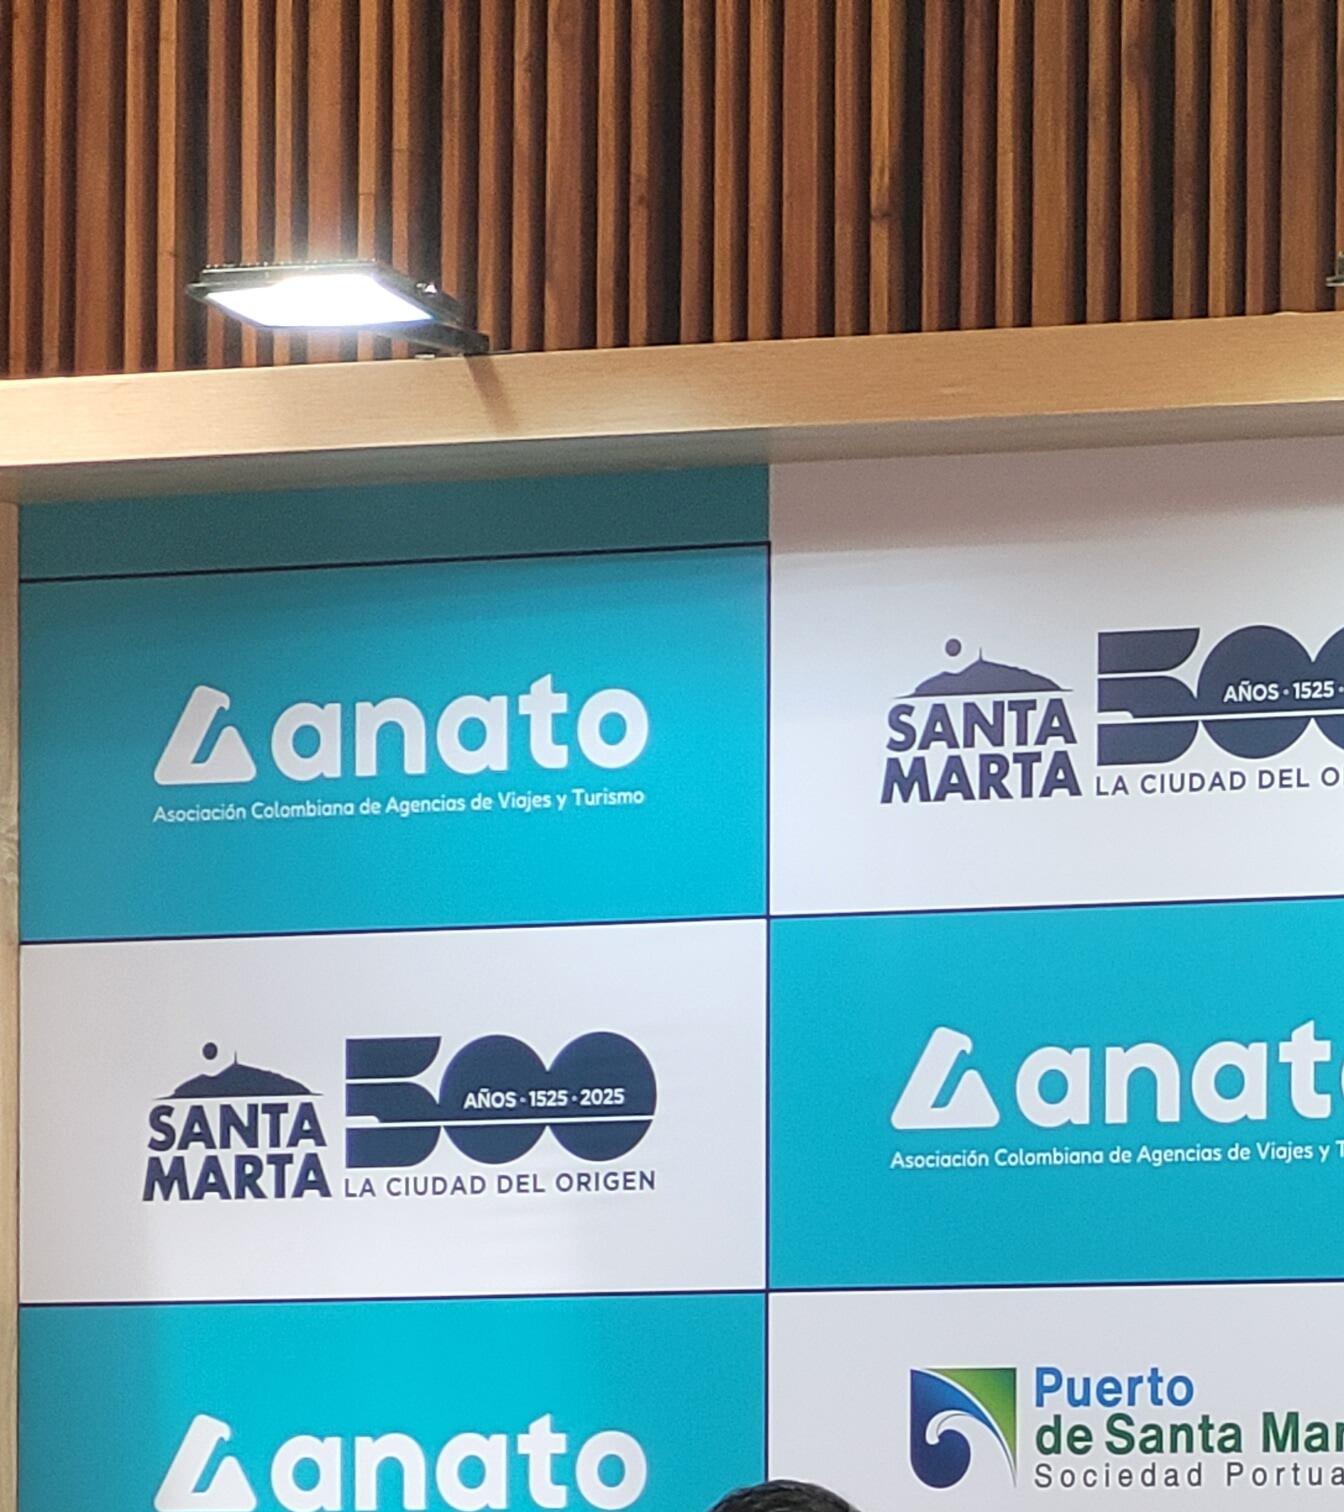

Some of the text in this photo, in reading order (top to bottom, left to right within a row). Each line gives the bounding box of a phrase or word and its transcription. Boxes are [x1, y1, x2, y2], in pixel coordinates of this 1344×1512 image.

[1223, 680, 1280, 703] AÑOS
[1292, 680, 1335, 699] 1525
[271, 673, 649, 782] anato
[885, 698, 1078, 752] SANTA
[879, 750, 1083, 805] MARTA
[1096, 775, 1129, 796] LA
[1140, 771, 1246, 794] CIUDAD
[1258, 768, 1310, 789] DEL
[152, 787, 645, 823] Asociación Colombiana de Agencias de Viajes y Turismo
[463, 1087, 625, 1109] AÑOS 1525 2025
[147, 1101, 328, 1152] SANTA
[890, 1149, 990, 1169] Asociación
[994, 1146, 1104, 1167] Colombiana
[1108, 1145, 1132, 1164] de
[1136, 1143, 1222, 1167] Agencias
[1227, 1142, 1251, 1161] de
[1256, 1141, 1314, 1164] Viajes
[1318, 1145, 1330, 1163] y
[141, 1151, 333, 1204] MARTA
[345, 1170, 655, 1198] LA CIUDAD DEL ORIGEN
[1034, 1364, 1195, 1409] Puerto
[1035, 1414, 1093, 1456] de
[1105, 1412, 1243, 1456] Santa
[271, 1411, 648, 1512] anato
[1034, 1461, 1202, 1488] Sociedad
